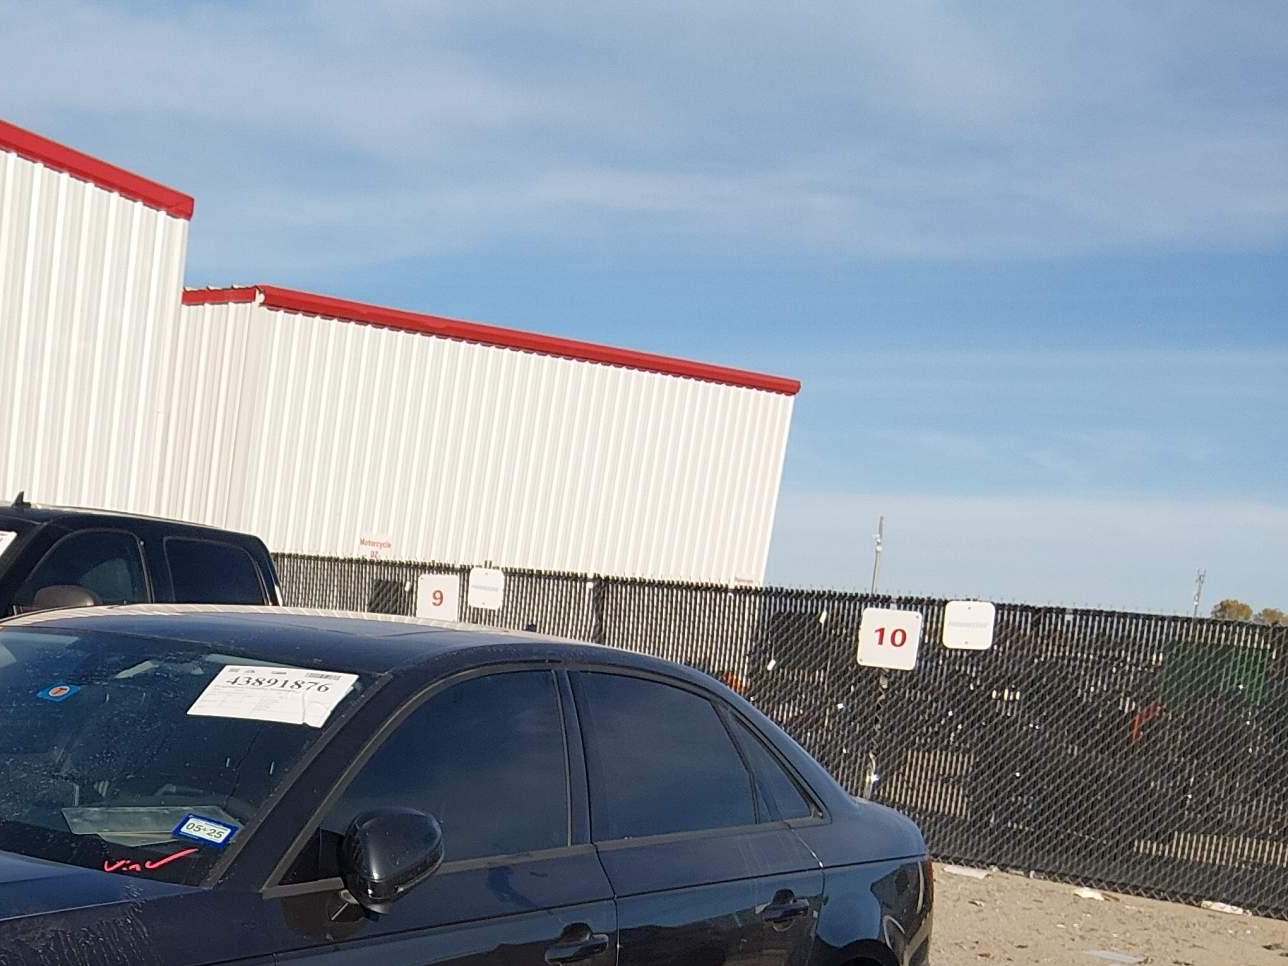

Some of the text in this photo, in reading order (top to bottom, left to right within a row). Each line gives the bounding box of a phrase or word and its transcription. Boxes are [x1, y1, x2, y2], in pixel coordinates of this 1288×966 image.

[431, 589, 444, 607] 9
[874, 627, 907, 648] 10
[225, 675, 330, 693] 43891876
